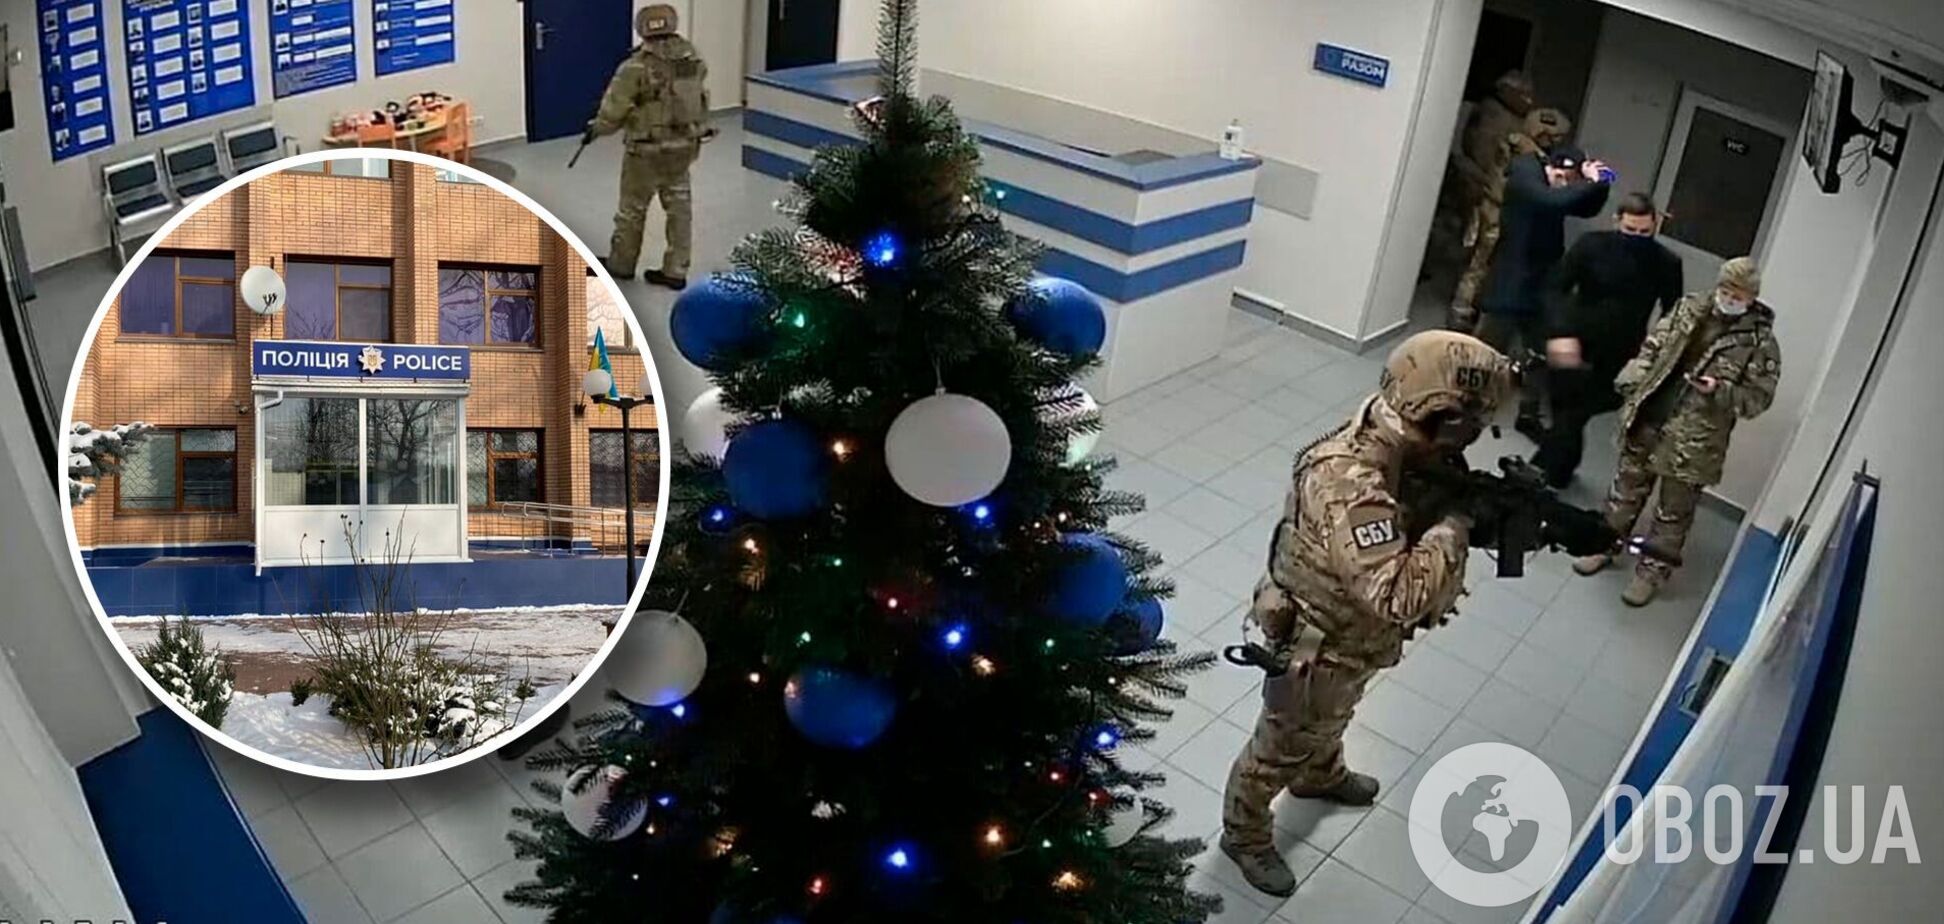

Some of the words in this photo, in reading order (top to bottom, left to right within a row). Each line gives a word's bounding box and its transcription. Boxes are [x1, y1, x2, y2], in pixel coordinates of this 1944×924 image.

[262, 350, 349, 370] ПОЛІЦІЯ
[393, 354, 462, 371] POLICE
[1456, 367, 1491, 389] СБУ
[1355, 519, 1394, 547] СБУ
